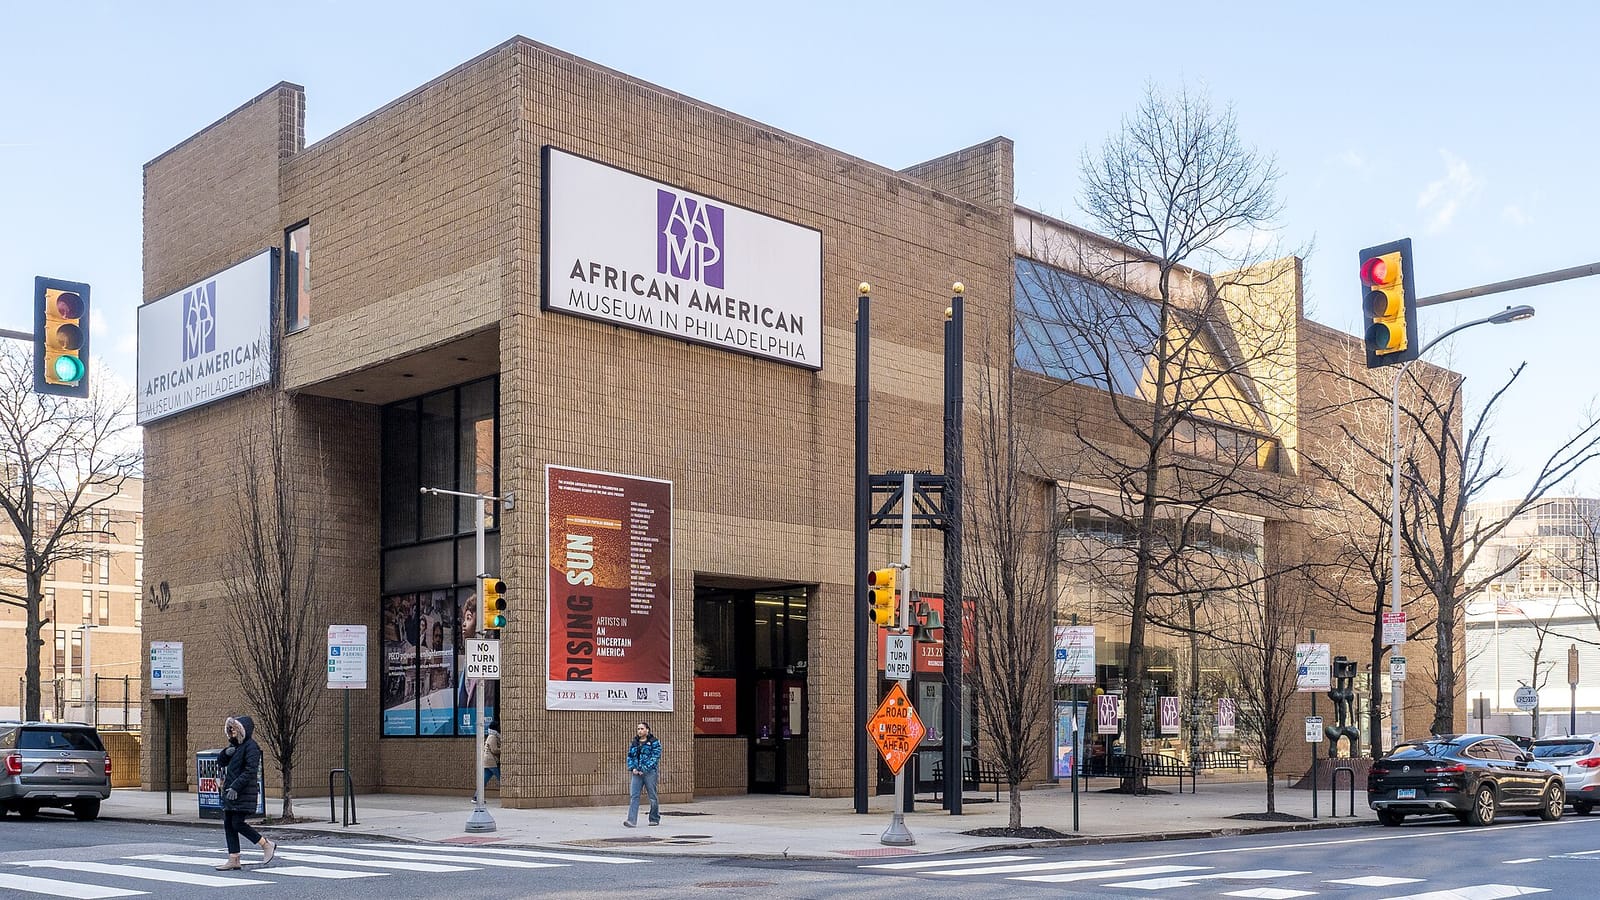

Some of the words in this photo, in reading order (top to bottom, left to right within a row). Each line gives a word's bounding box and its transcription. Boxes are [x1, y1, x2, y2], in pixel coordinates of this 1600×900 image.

[570, 258, 680, 305] AFRICAN
[688, 289, 804, 336] AMERICAN
[569, 288, 653, 325] MUSEUM
[660, 310, 679, 331] IN
[685, 316, 806, 361] PHILADELPHIA
[145, 364, 194, 398] AFRICAN
[197, 339, 261, 378] AMERICAN
[145, 394, 182, 418] MUSEUM
[184, 389, 193, 405] IN
[195, 366, 262, 399] PHILADELPHIA
[566, 533, 594, 586] SUN
[596, 616, 621, 627] ARTISTS
[621, 618, 628, 627] IN
[596, 627, 606, 636] AN
[566, 594, 593, 681] RISING
[596, 637, 632, 648] UNCERTAIN
[477, 643, 489, 652] NO
[894, 639, 904, 649] NO
[596, 647, 626, 657] AMERICA
[890, 651, 908, 661] TURN
[471, 654, 495, 663] TURN
[468, 664, 480, 673] ON
[482, 664, 498, 674] RED
[887, 663, 896, 673] ON
[896, 663, 910, 673] RED
[607, 689, 628, 699] PAFA
[885, 706, 908, 718] ROAD
[885, 723, 907, 734] WORK
[882, 740, 910, 752] AHEAD
